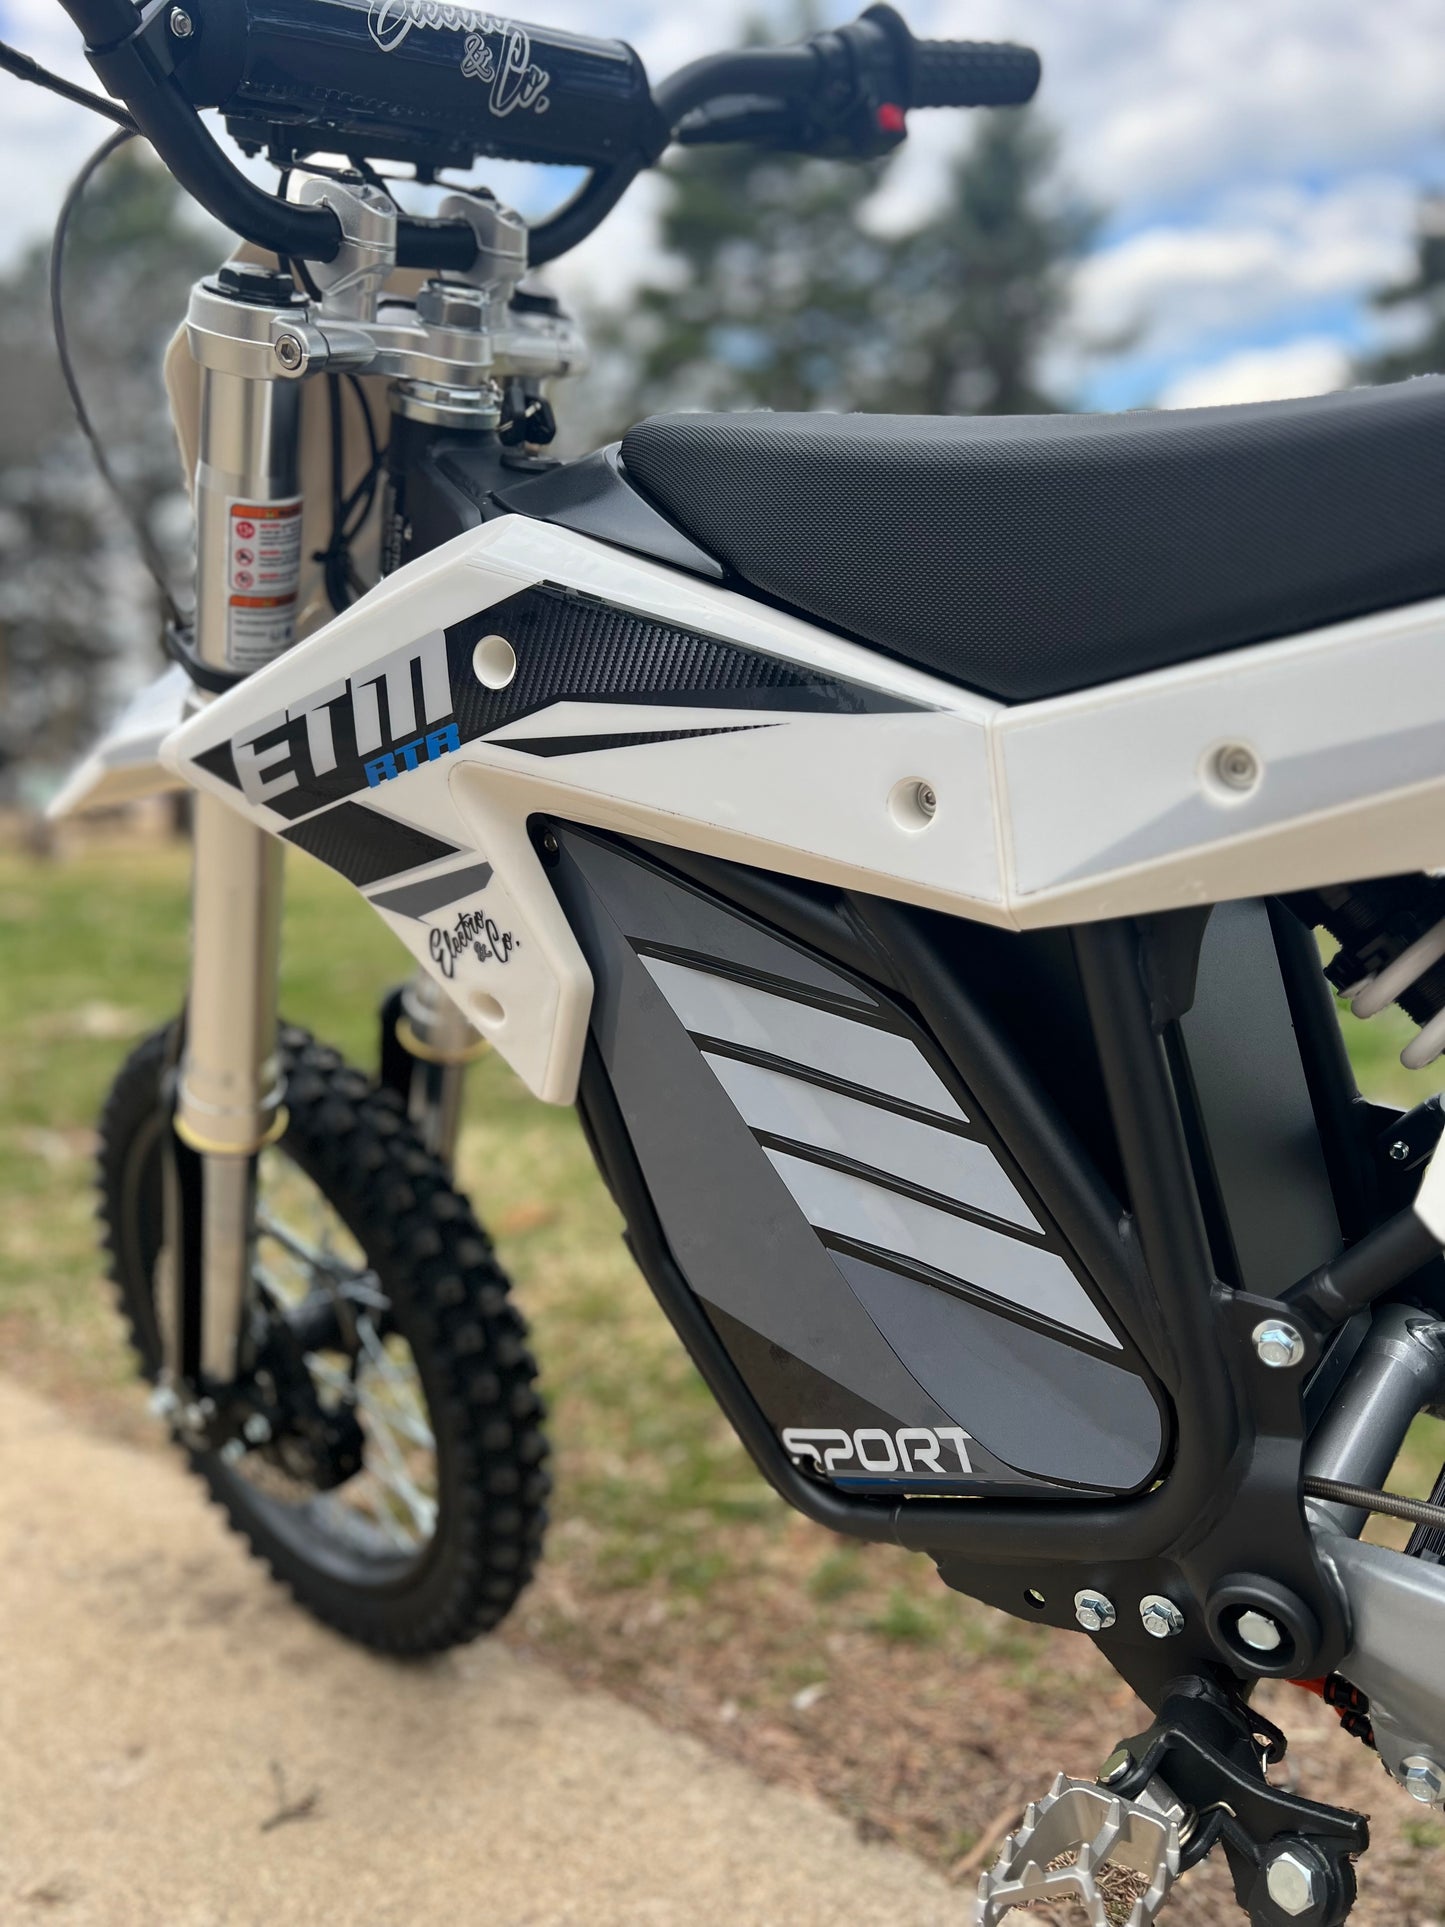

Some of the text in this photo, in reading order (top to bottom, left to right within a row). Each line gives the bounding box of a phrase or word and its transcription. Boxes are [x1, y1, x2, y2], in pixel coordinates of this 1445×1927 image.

[460, 32, 494, 83] &
[489, 21, 550, 118] Co.
[231, 628, 453, 806] ETM
[363, 722, 461, 788] RTR
[429, 910, 520, 979] Electro & Co.
[782, 1427, 972, 1473] SPORT
